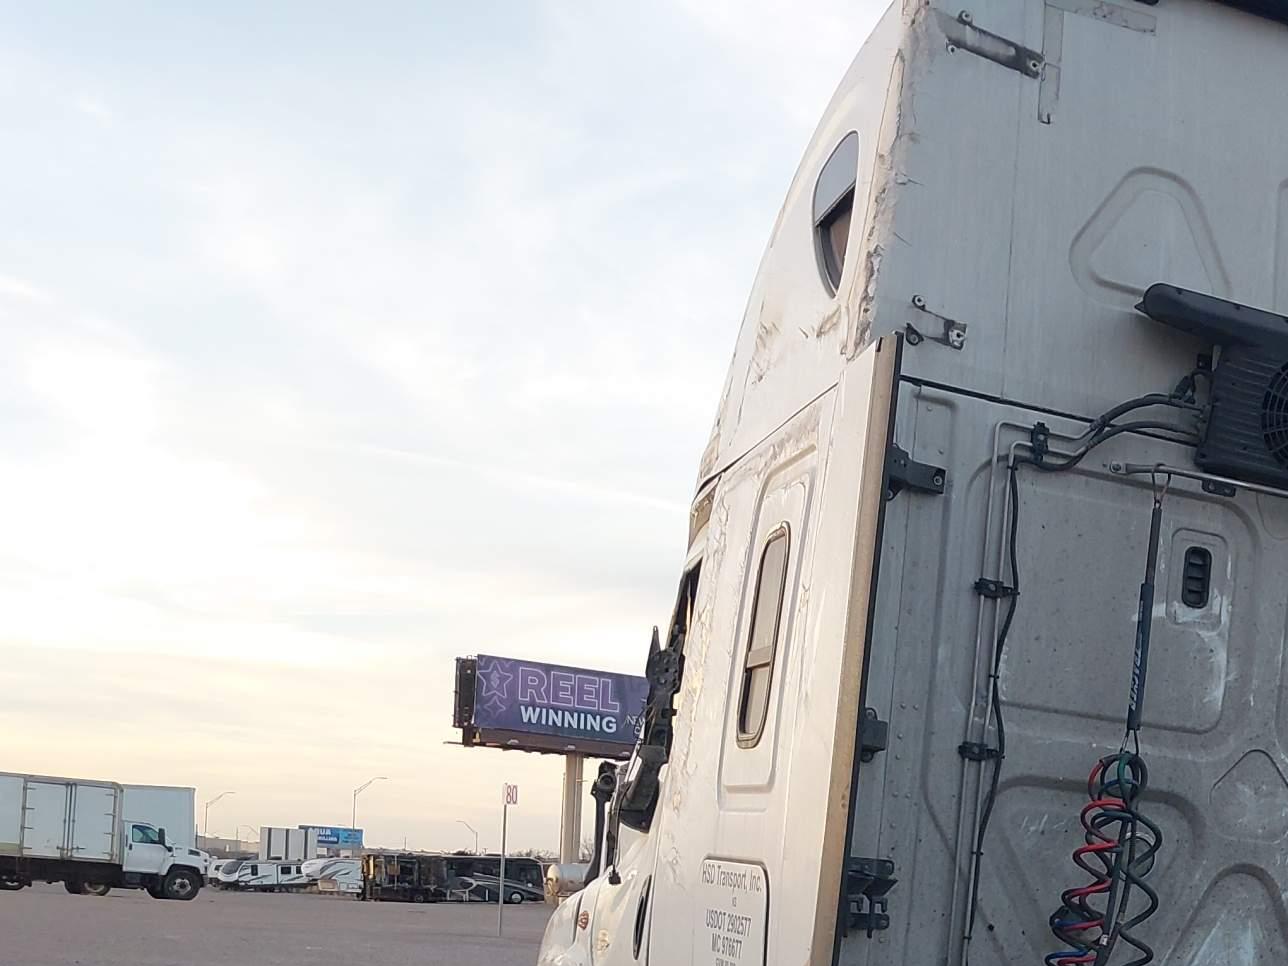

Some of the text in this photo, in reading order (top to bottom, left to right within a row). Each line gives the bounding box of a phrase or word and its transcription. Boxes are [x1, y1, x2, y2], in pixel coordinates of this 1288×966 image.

[518, 667, 620, 713] REEL
[520, 705, 617, 734] WINNING
[749, 870, 762, 893] Inc.
[706, 909, 727, 932] USDOT
[711, 933, 743, 959] MC 976677
